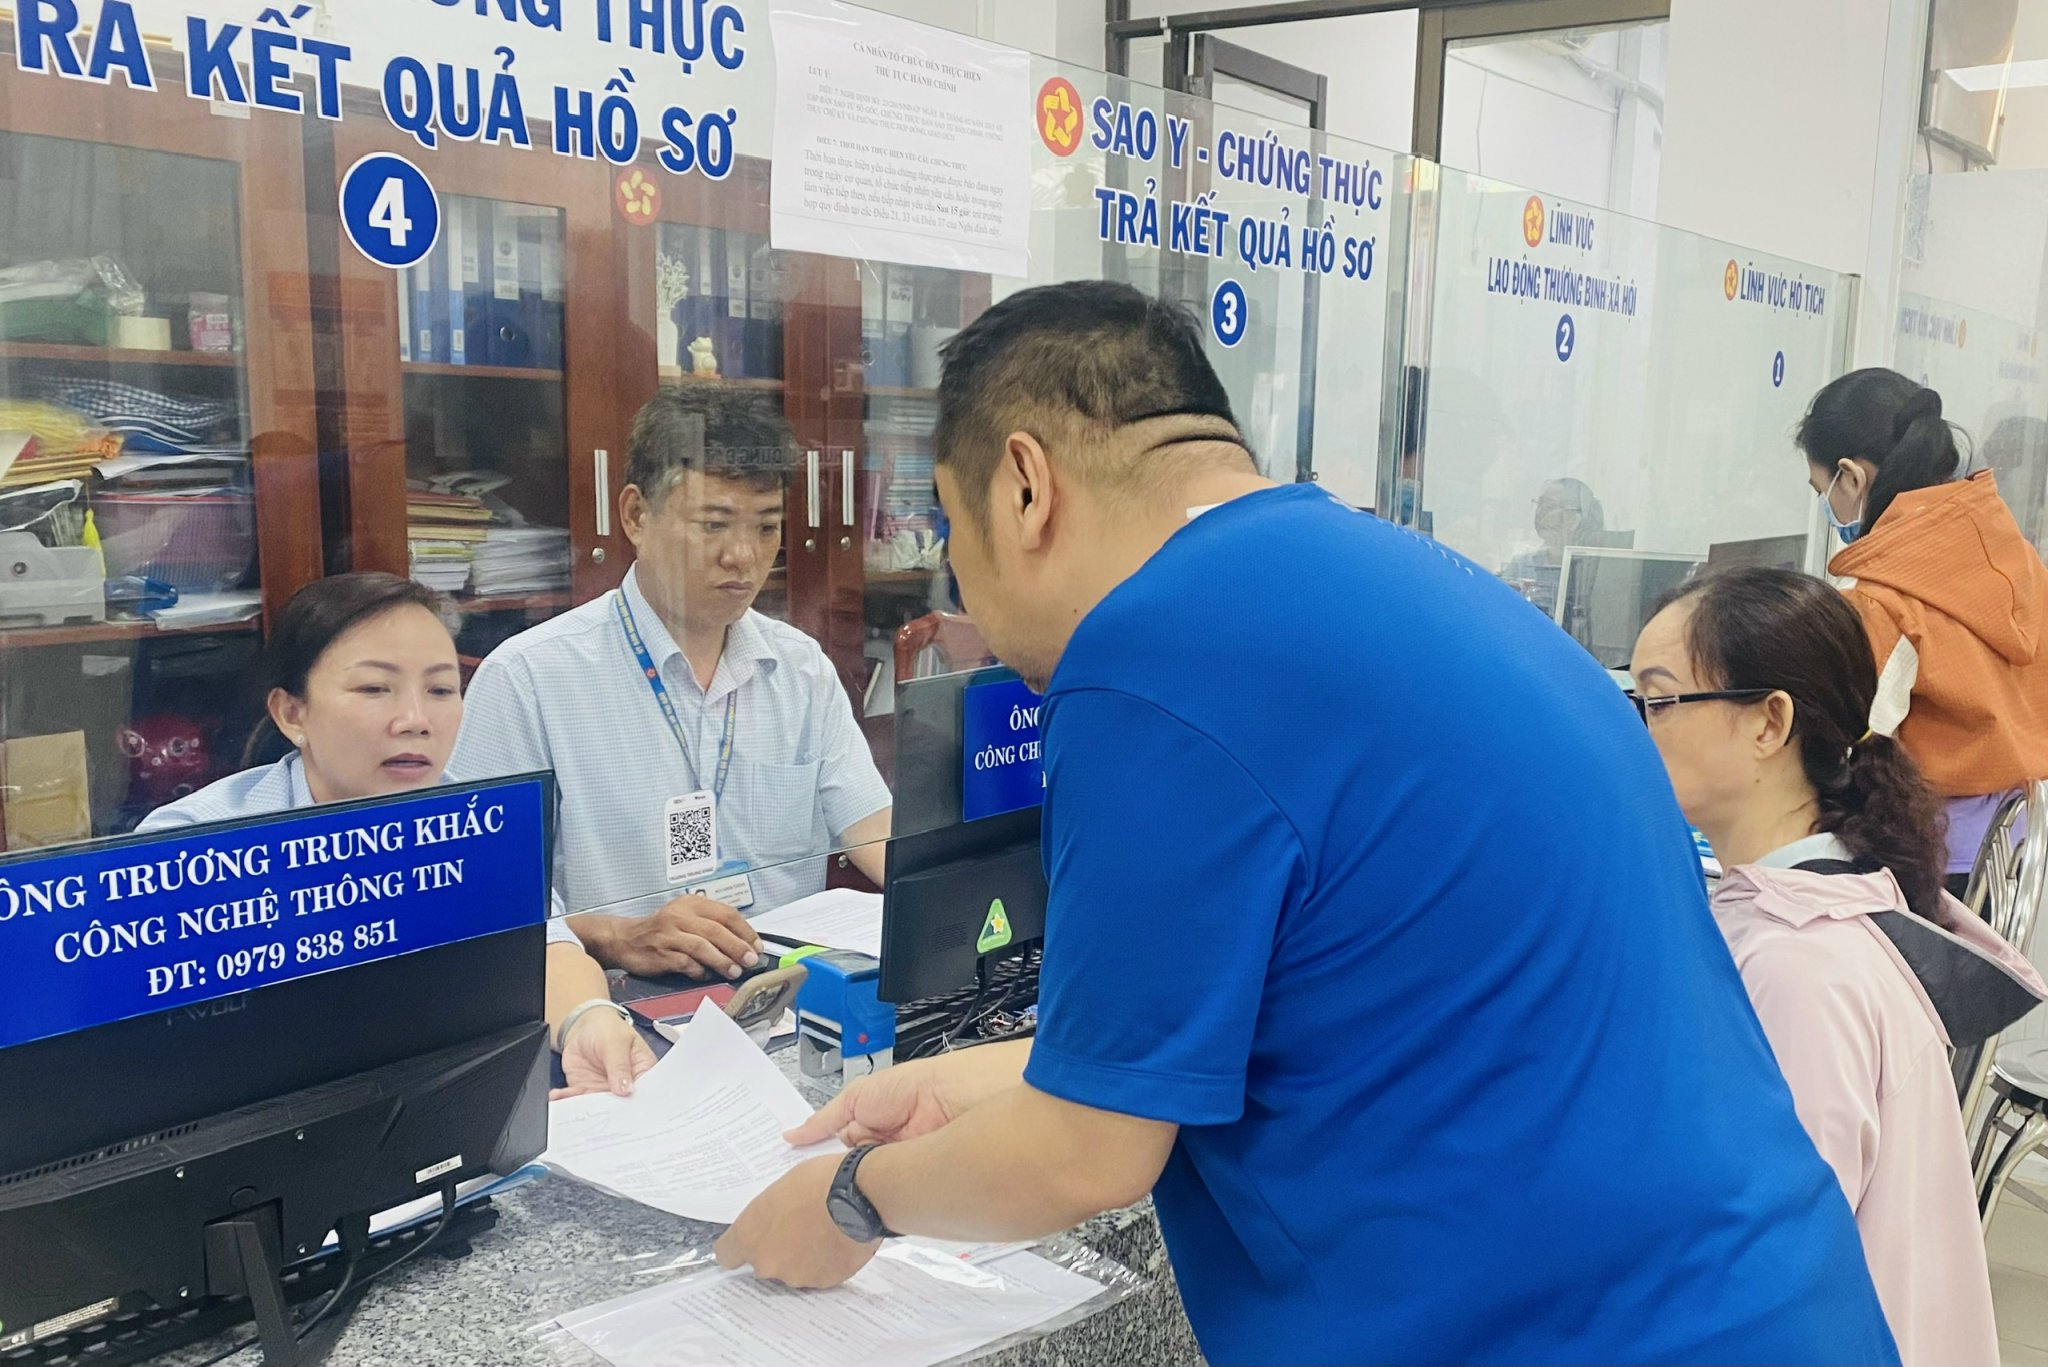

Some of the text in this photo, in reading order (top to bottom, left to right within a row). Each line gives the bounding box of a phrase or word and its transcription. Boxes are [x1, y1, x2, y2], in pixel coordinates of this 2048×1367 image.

[186, 4, 352, 118] KẾT
[384, 46, 529, 147] QUẢ
[554, 67, 639, 163] HỒ
[659, 107, 737, 178] SƠ
[1091, 97, 1383, 216] SAO Y - CHỨNG THỰC
[368, 177, 413, 246] 4
[1095, 179, 1377, 281] TRẢ KẾT QUẢ HỒ SƠ
[1549, 202, 1594, 257] LĨNH VỰC
[1221, 292, 1237, 335] 3
[1488, 257, 1510, 294] LAO
[1512, 253, 1541, 305] ĐỘNG
[1544, 264, 1583, 306] THƯƠNG
[1621, 278, 1637, 323] HỘI
[1740, 261, 1825, 320] LĨNH VỰC HỘ TỊCH
[1559, 322, 1571, 353] 2
[1775, 357, 1781, 382] 1
[974, 740, 1042, 771] CÔNG CH
[0, 794, 504, 921] ÔNG TRƯƠNG TRUNG KHẮC
[54, 859, 464, 963] CÔNG NGHỆ THÔNG TIN
[146, 918, 399, 997] ĐT: 0979 838 851
